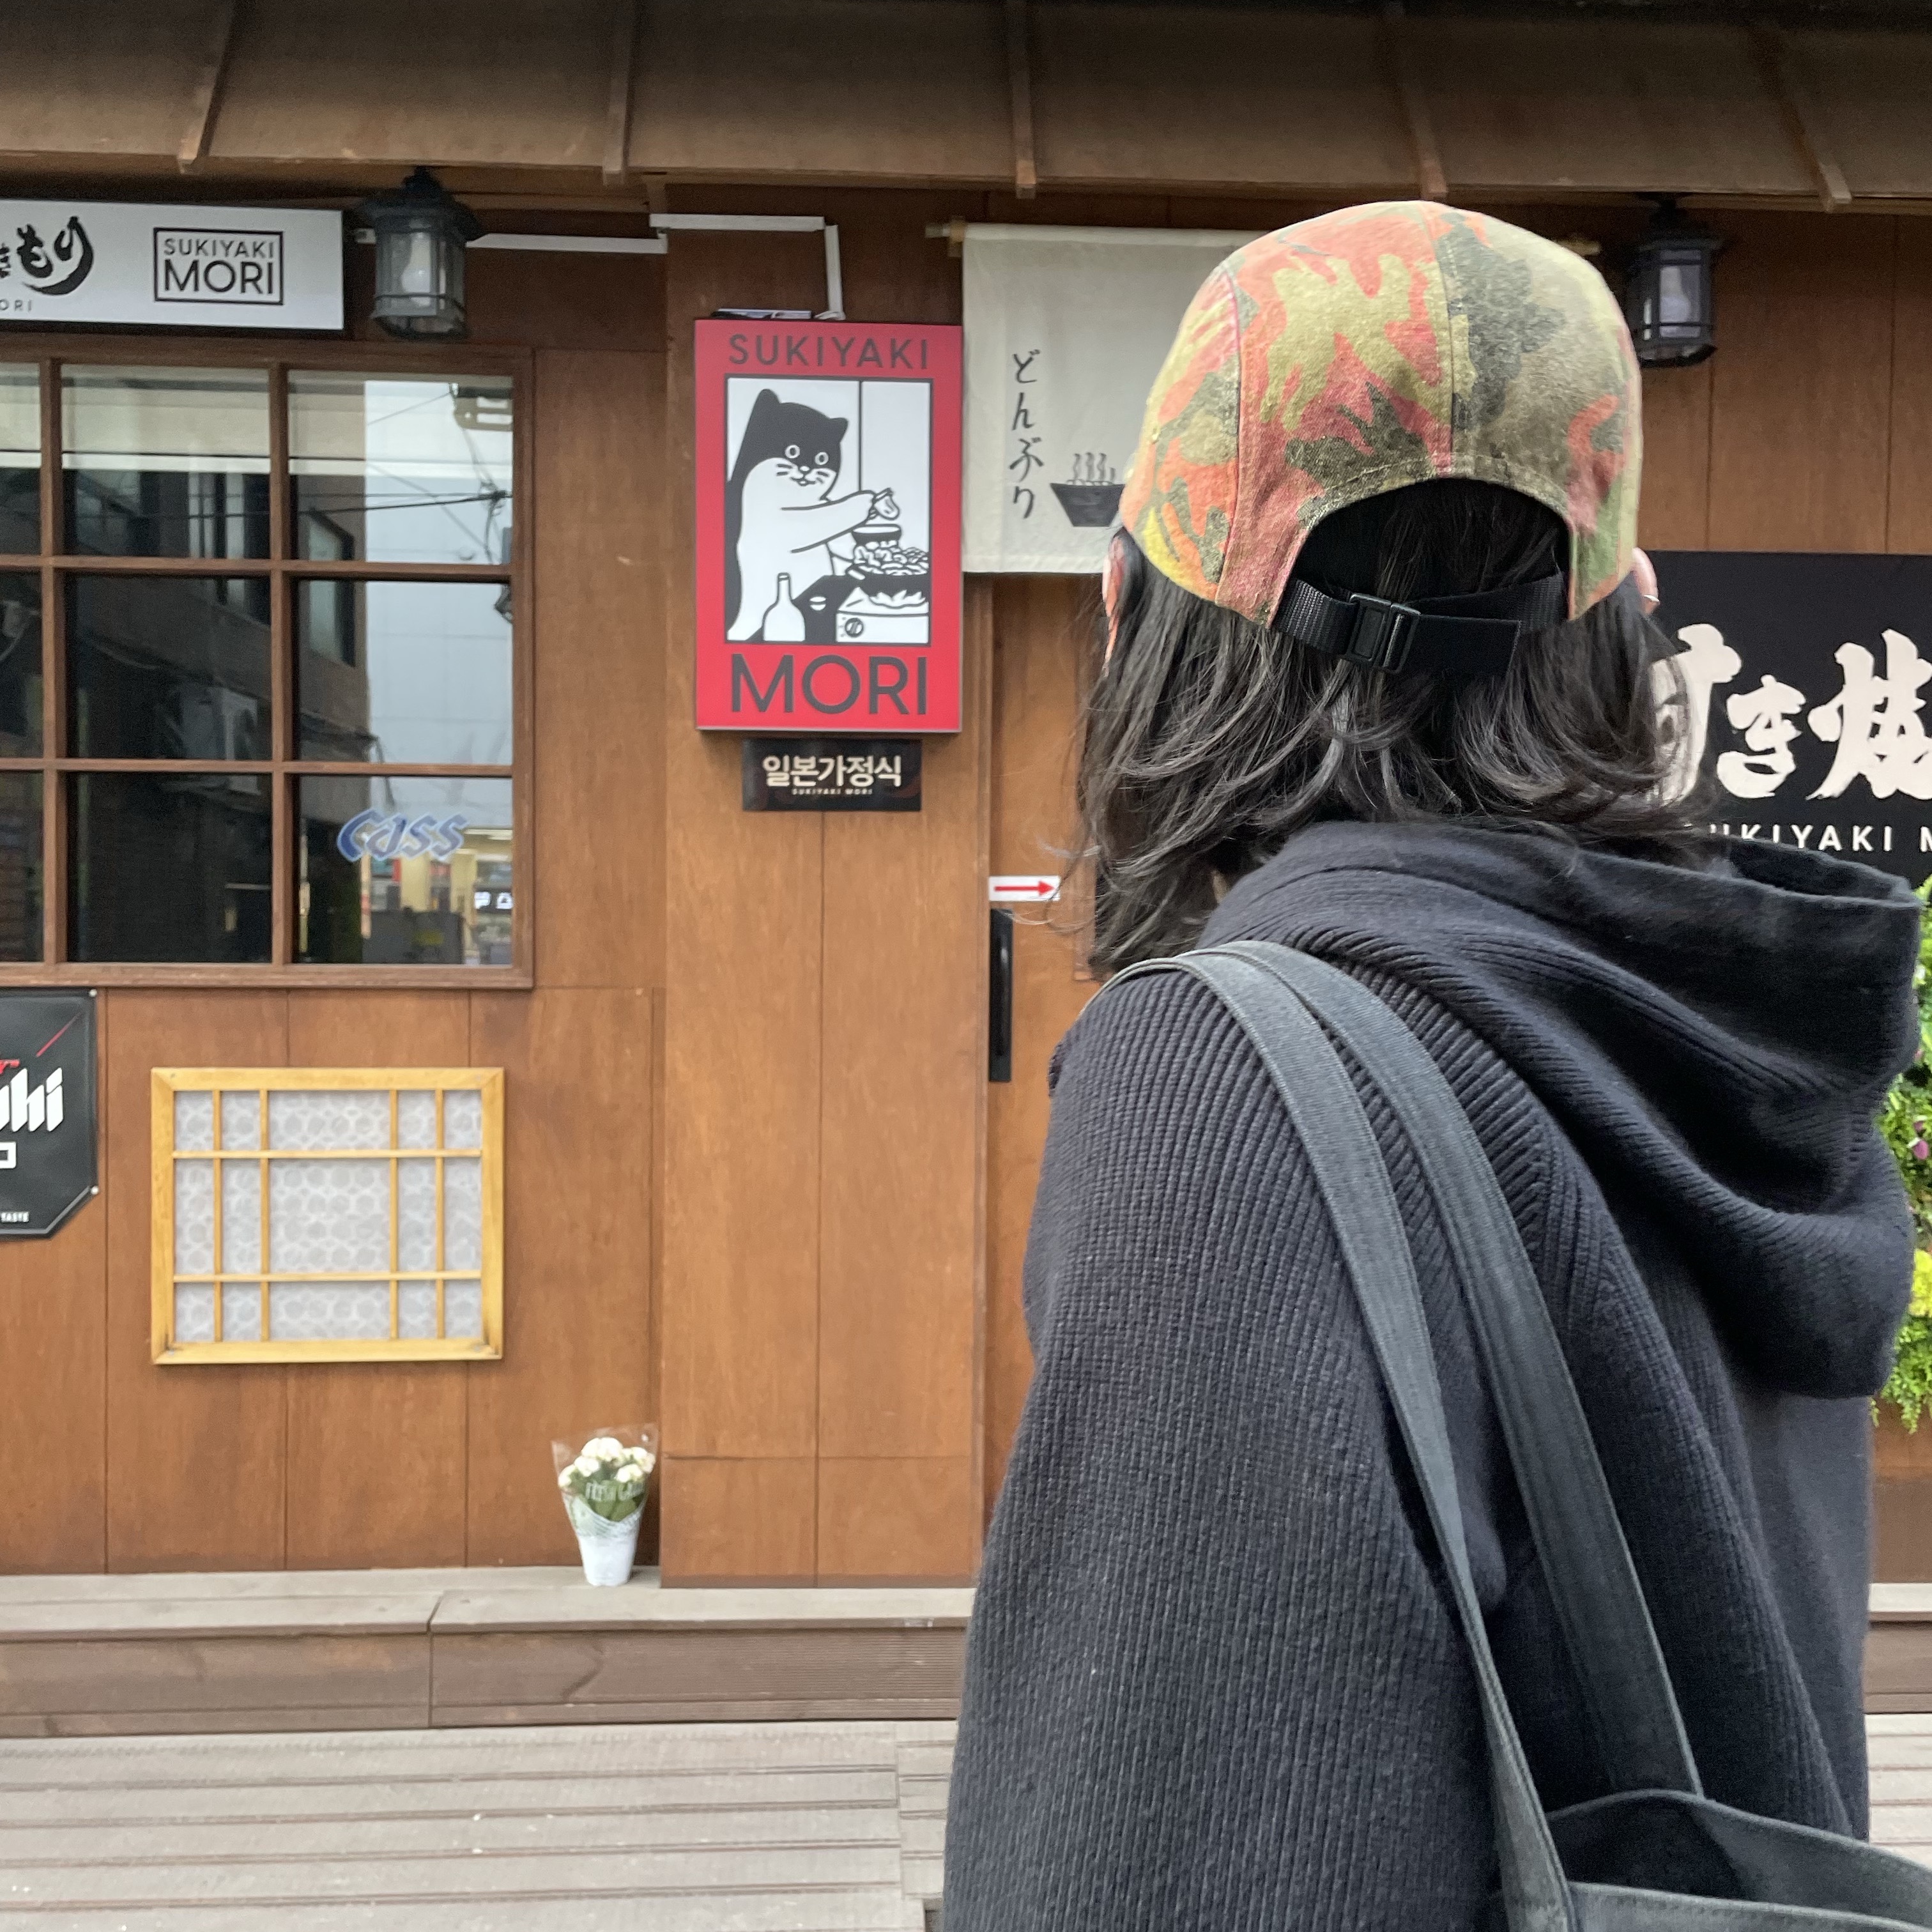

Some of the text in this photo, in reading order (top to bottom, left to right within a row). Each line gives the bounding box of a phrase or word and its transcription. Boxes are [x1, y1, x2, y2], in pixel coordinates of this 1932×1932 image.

[0, 216, 94, 295] もり
[164, 238, 275, 259] SUKIYAKI
[164, 259, 273, 294] MORI
[728, 333, 929, 370] SUKIYAKI
[1009, 349, 1045, 519] どんぶり
[732, 654, 927, 716] MORI
[763, 755, 901, 787] 일본가정식
[1684, 823, 1892, 852] KIYAKI
